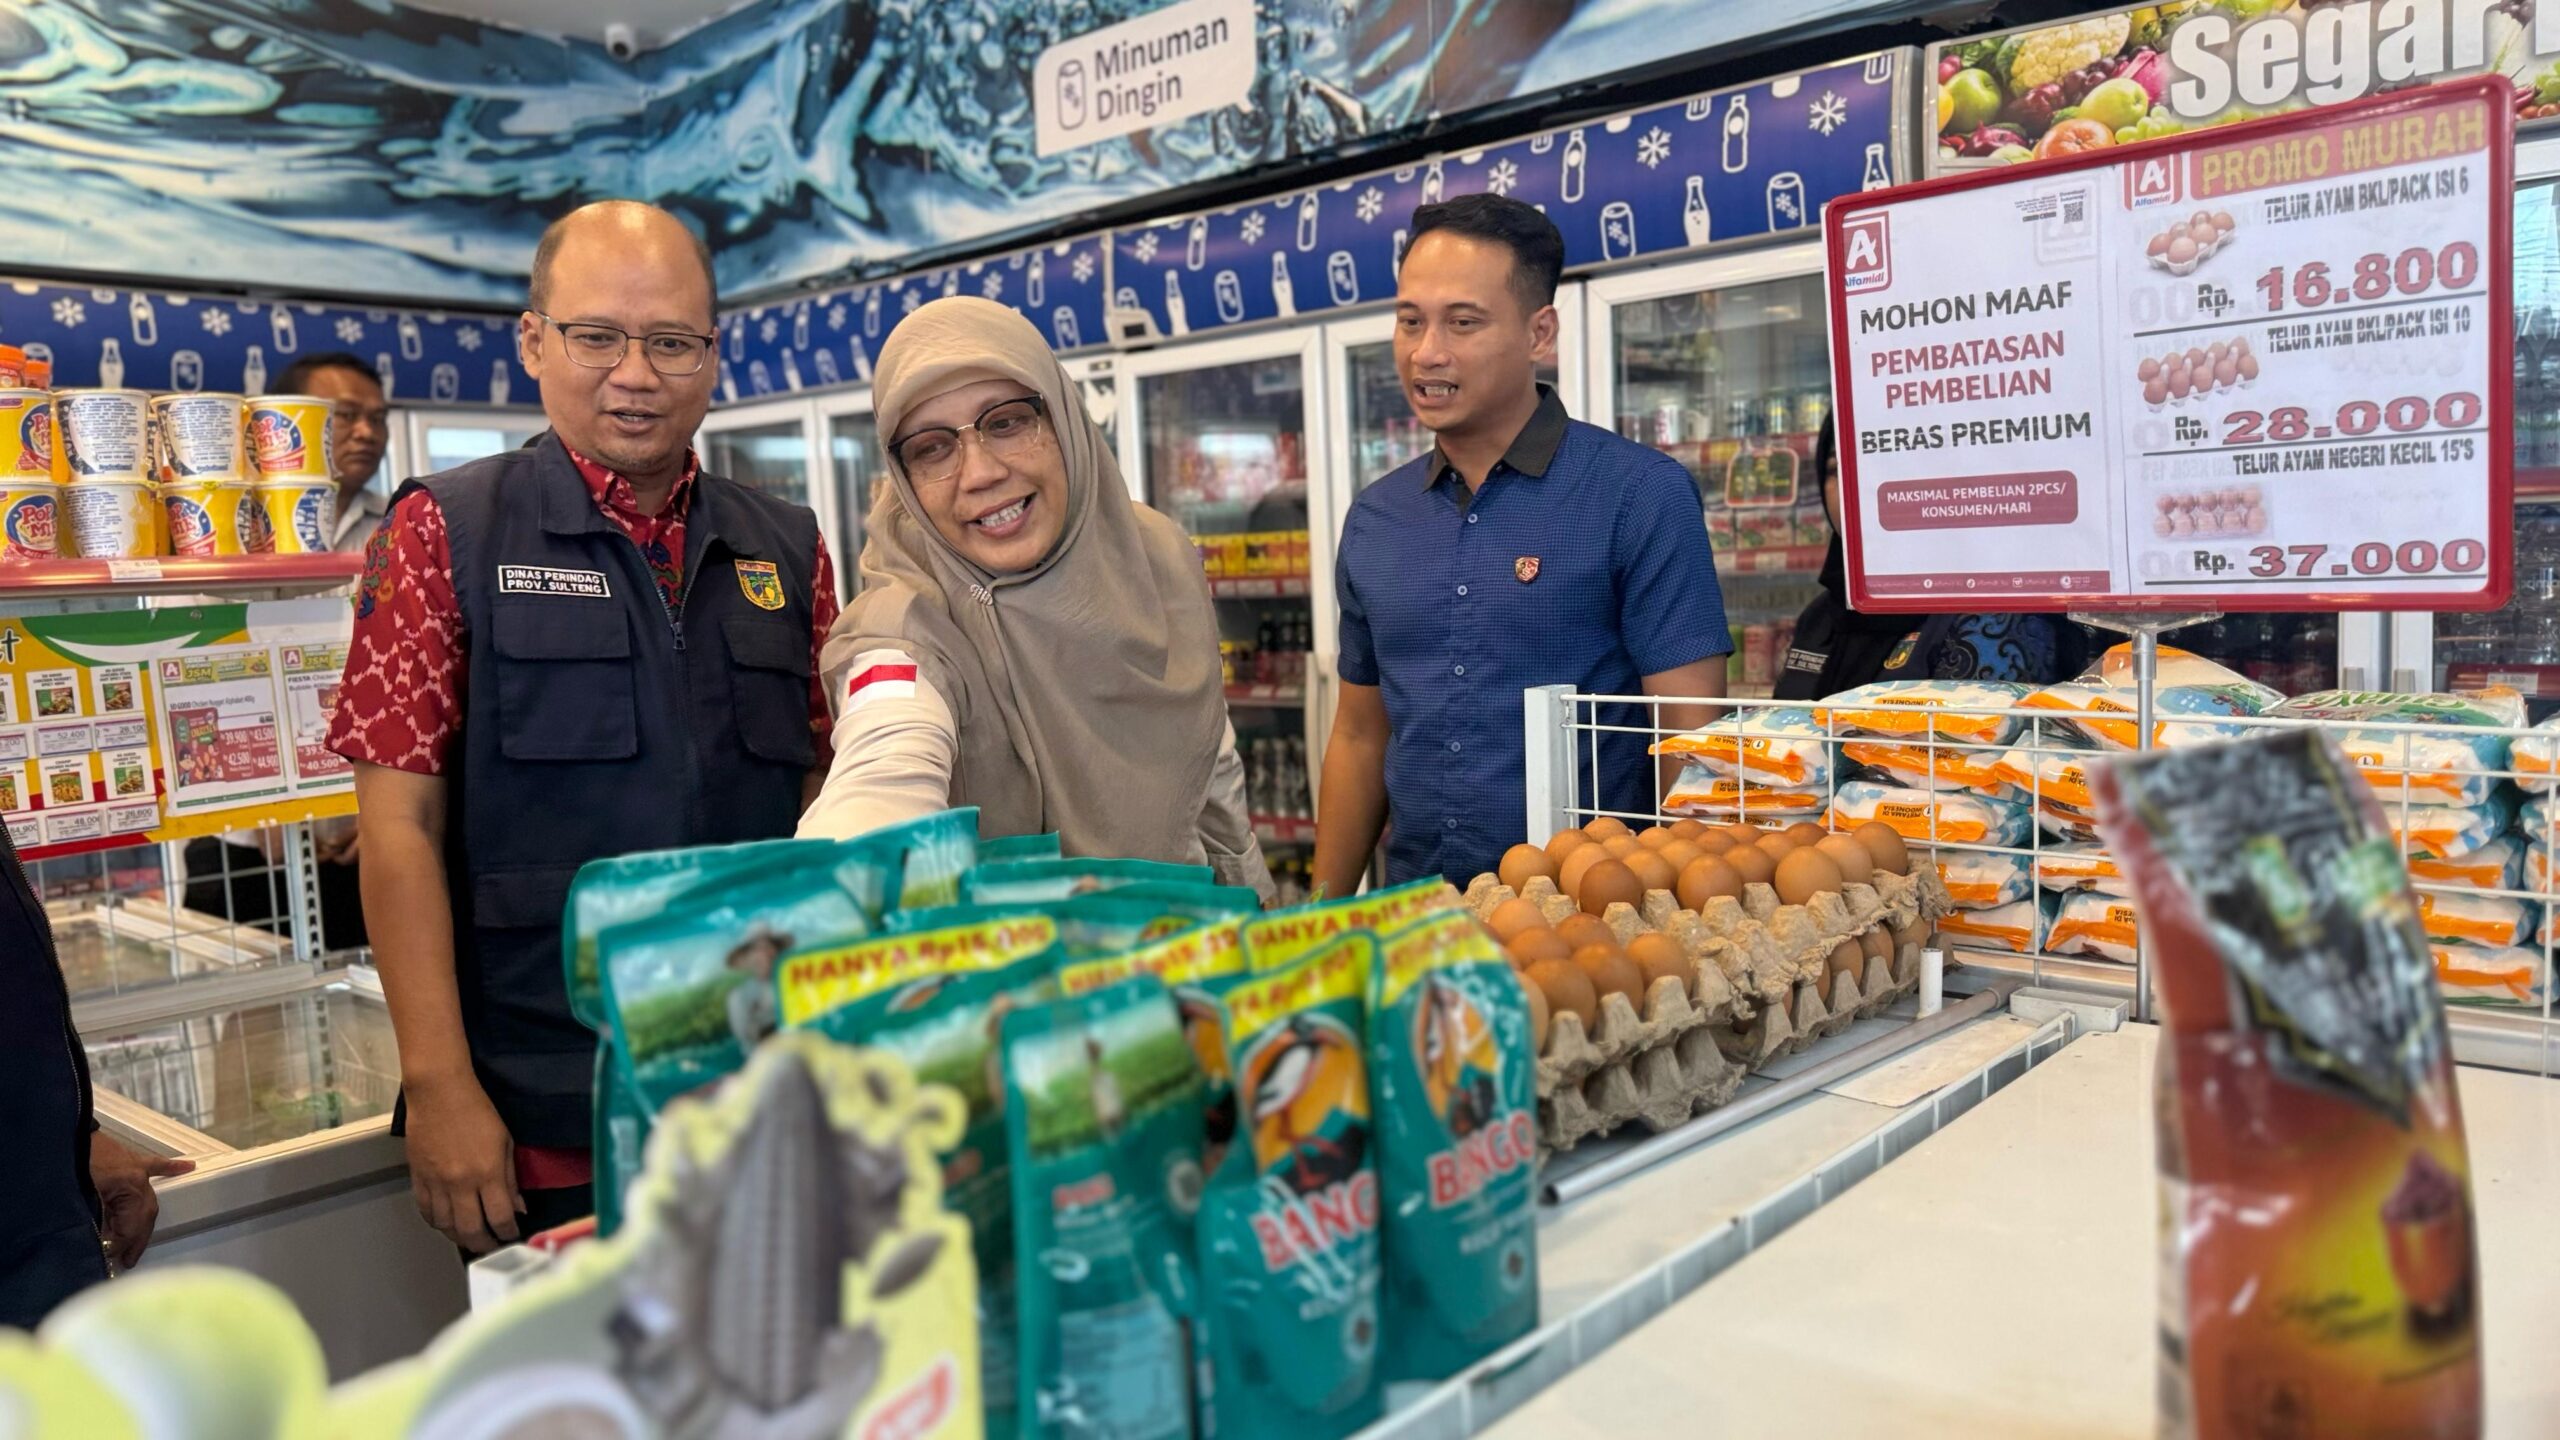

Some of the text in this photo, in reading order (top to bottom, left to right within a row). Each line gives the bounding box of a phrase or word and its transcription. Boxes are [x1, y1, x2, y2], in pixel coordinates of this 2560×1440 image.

[1094, 17, 1228, 82] Minuman
[1096, 70, 1182, 123] Dingin
[2202, 105, 2485, 196] PROMO MURAH
[2134, 194, 2171, 207] Alfamidi
[2265, 167, 2469, 224] TELUR AYAM BKL/PACK ISI 6
[2197, 241, 2479, 318] Rp. 16.800
[1860, 281, 2072, 334] MOHON MAAF
[2267, 327, 2311, 354] TELUR
[2314, 319, 2355, 348] AYAM
[2430, 307, 2449, 335] ISI
[2453, 305, 2471, 334] 10
[1871, 330, 2065, 377] PEMBATASAN
[1886, 368, 2051, 409] PEMBELIAN
[1861, 412, 2092, 454] BERAS PREMIUM
[2222, 391, 2482, 445] 28.000
[2233, 437, 2475, 475] TELUR AYAM NEGERI KECIL 15'S
[1887, 481, 2067, 503] MAKSIMAL PEMBELIAN 2PCS/
[1921, 501, 2031, 518] KONSUMEN/HARI
[29, 523, 57, 539] MI
[506, 569, 601, 584] DINAS PERINDAG
[2194, 538, 2486, 577] Rp. 37.000
[507, 579, 602, 594] PROV. SULTENG
[185, 667, 212, 679] JSM
[305, 656, 329, 666] JSM
[307, 758, 339, 770] 40.500
[1883, 804, 1923, 813] INDONESIA
[789, 946, 908, 986] HANYA
[1430, 1111, 1537, 1209] BANGO
[1249, 1170, 1377, 1272] BANG
